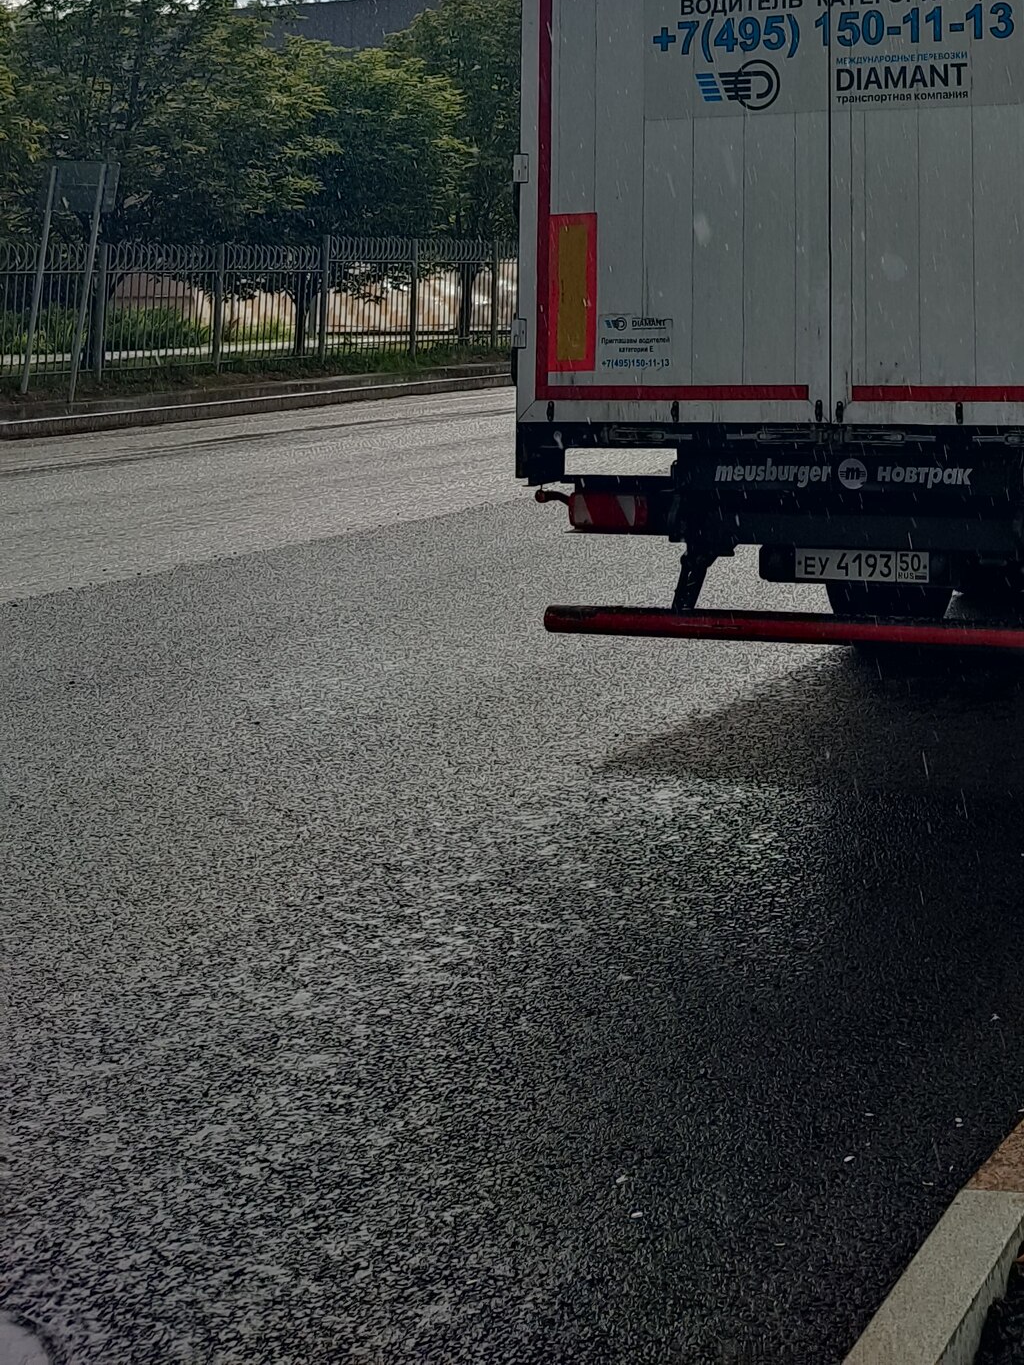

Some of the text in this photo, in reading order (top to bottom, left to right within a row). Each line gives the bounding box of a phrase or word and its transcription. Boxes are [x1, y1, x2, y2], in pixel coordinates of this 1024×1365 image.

[653, 2, 1015, 63] +7(495) 150-11-13
[836, 51, 968, 65] МЕЖДУНАРОДНЫЕ ПЕРЕВОЗКИ
[836, 63, 968, 91] DIAMANT
[836, 91, 968, 105] транспортная компания
[601, 359, 670, 368] +7(495)150-11-13
[714, 458, 832, 487] meusburger
[877, 466, 973, 488] новтрак
[836, 553, 892, 577] 4193
[899, 553, 921, 571] 50
[898, 572, 914, 580] RUS
